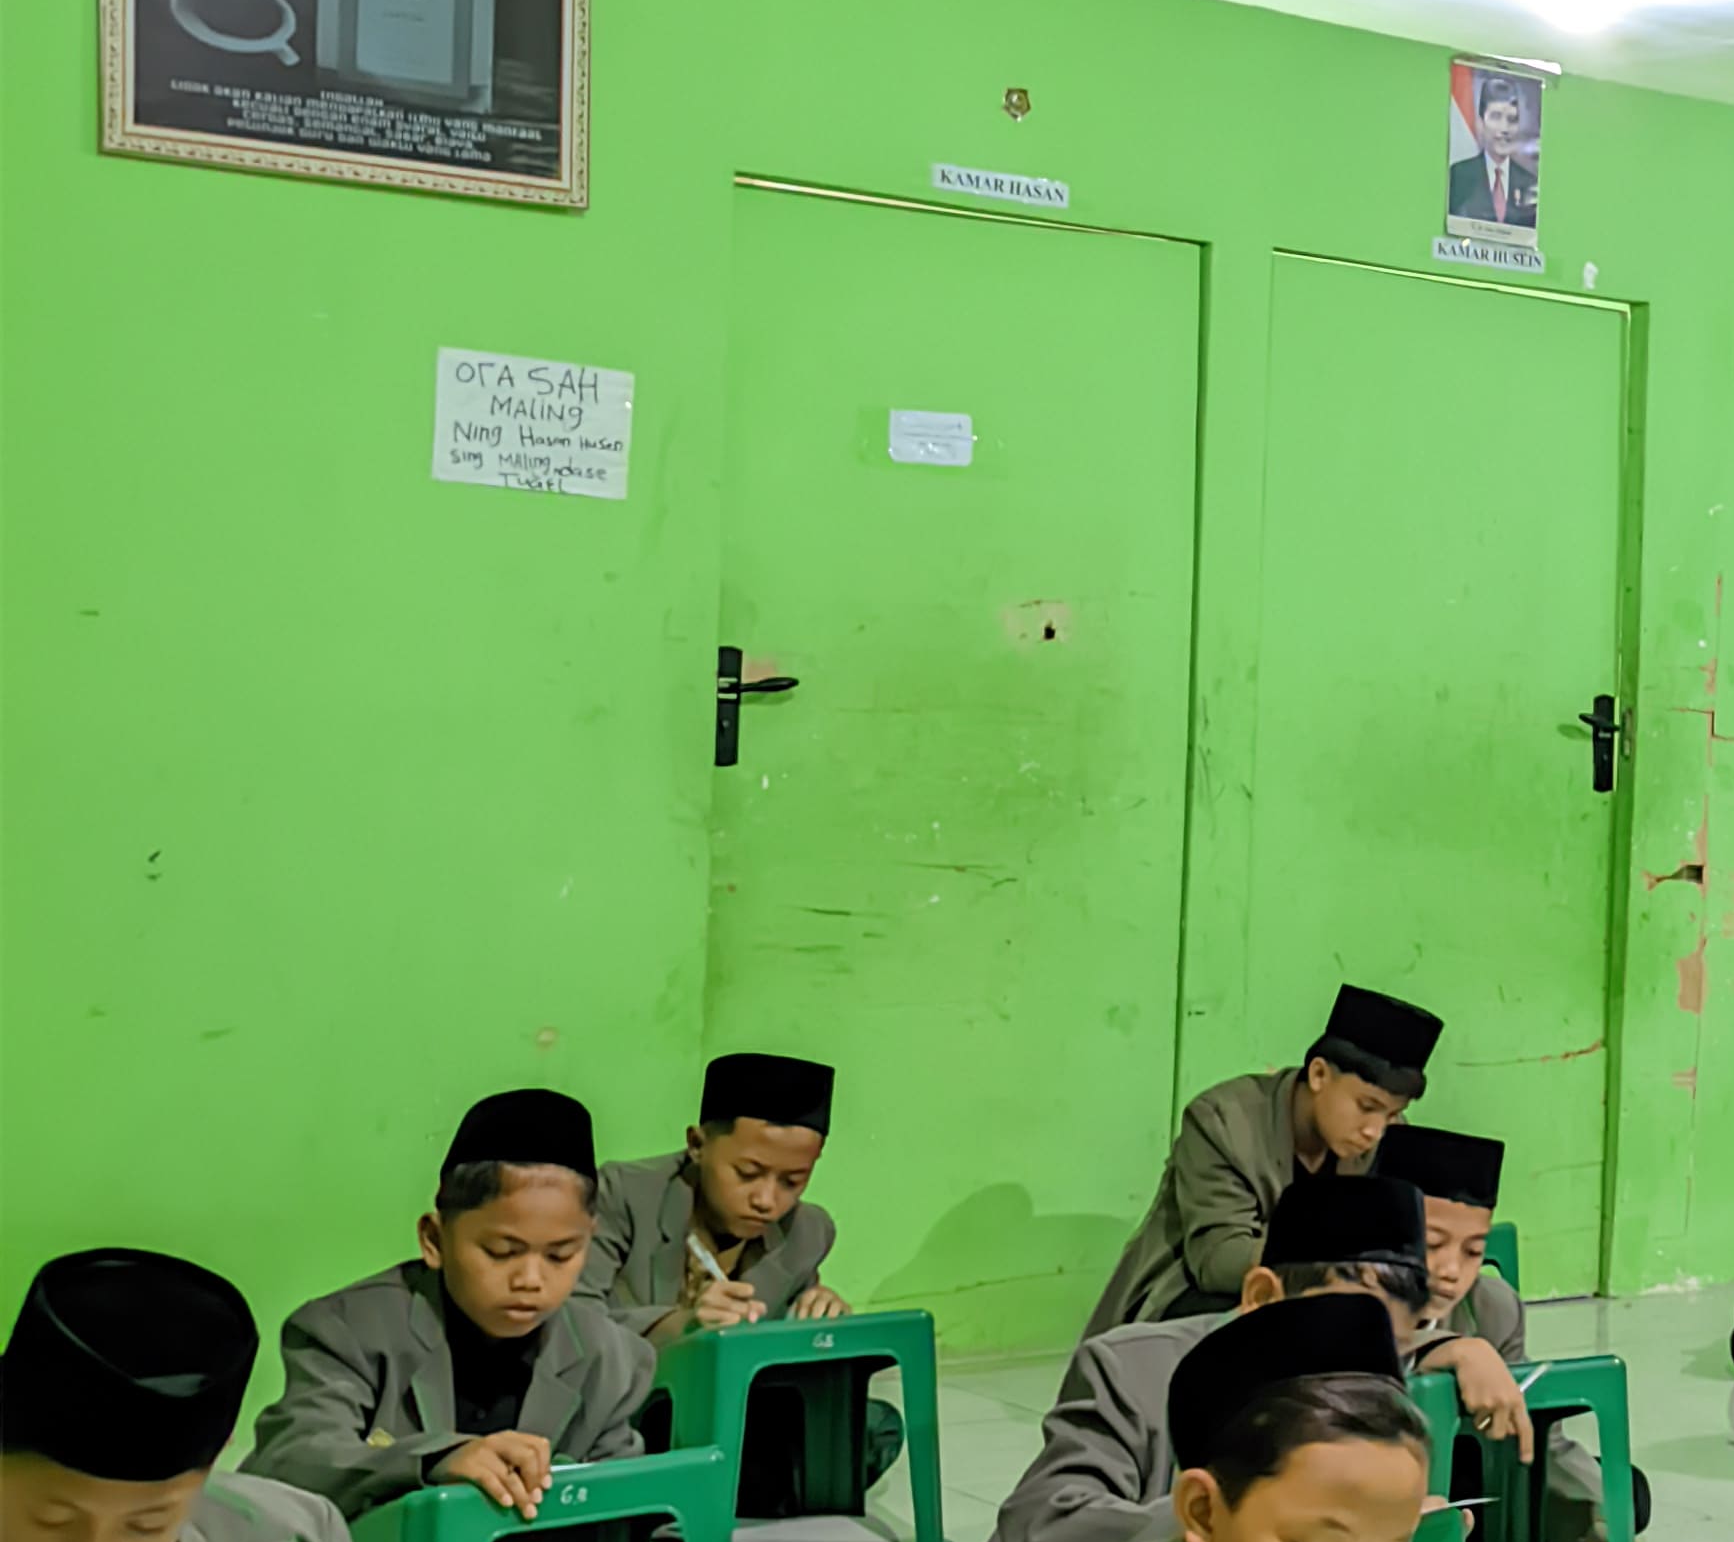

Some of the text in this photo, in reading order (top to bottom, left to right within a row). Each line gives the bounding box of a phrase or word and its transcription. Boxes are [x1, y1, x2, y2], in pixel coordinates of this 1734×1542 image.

[941, 168, 1064, 202] KAMAR HASAN
[1437, 242, 1543, 268] KAMAR HUSEIN
[528, 366, 599, 404] SAH
